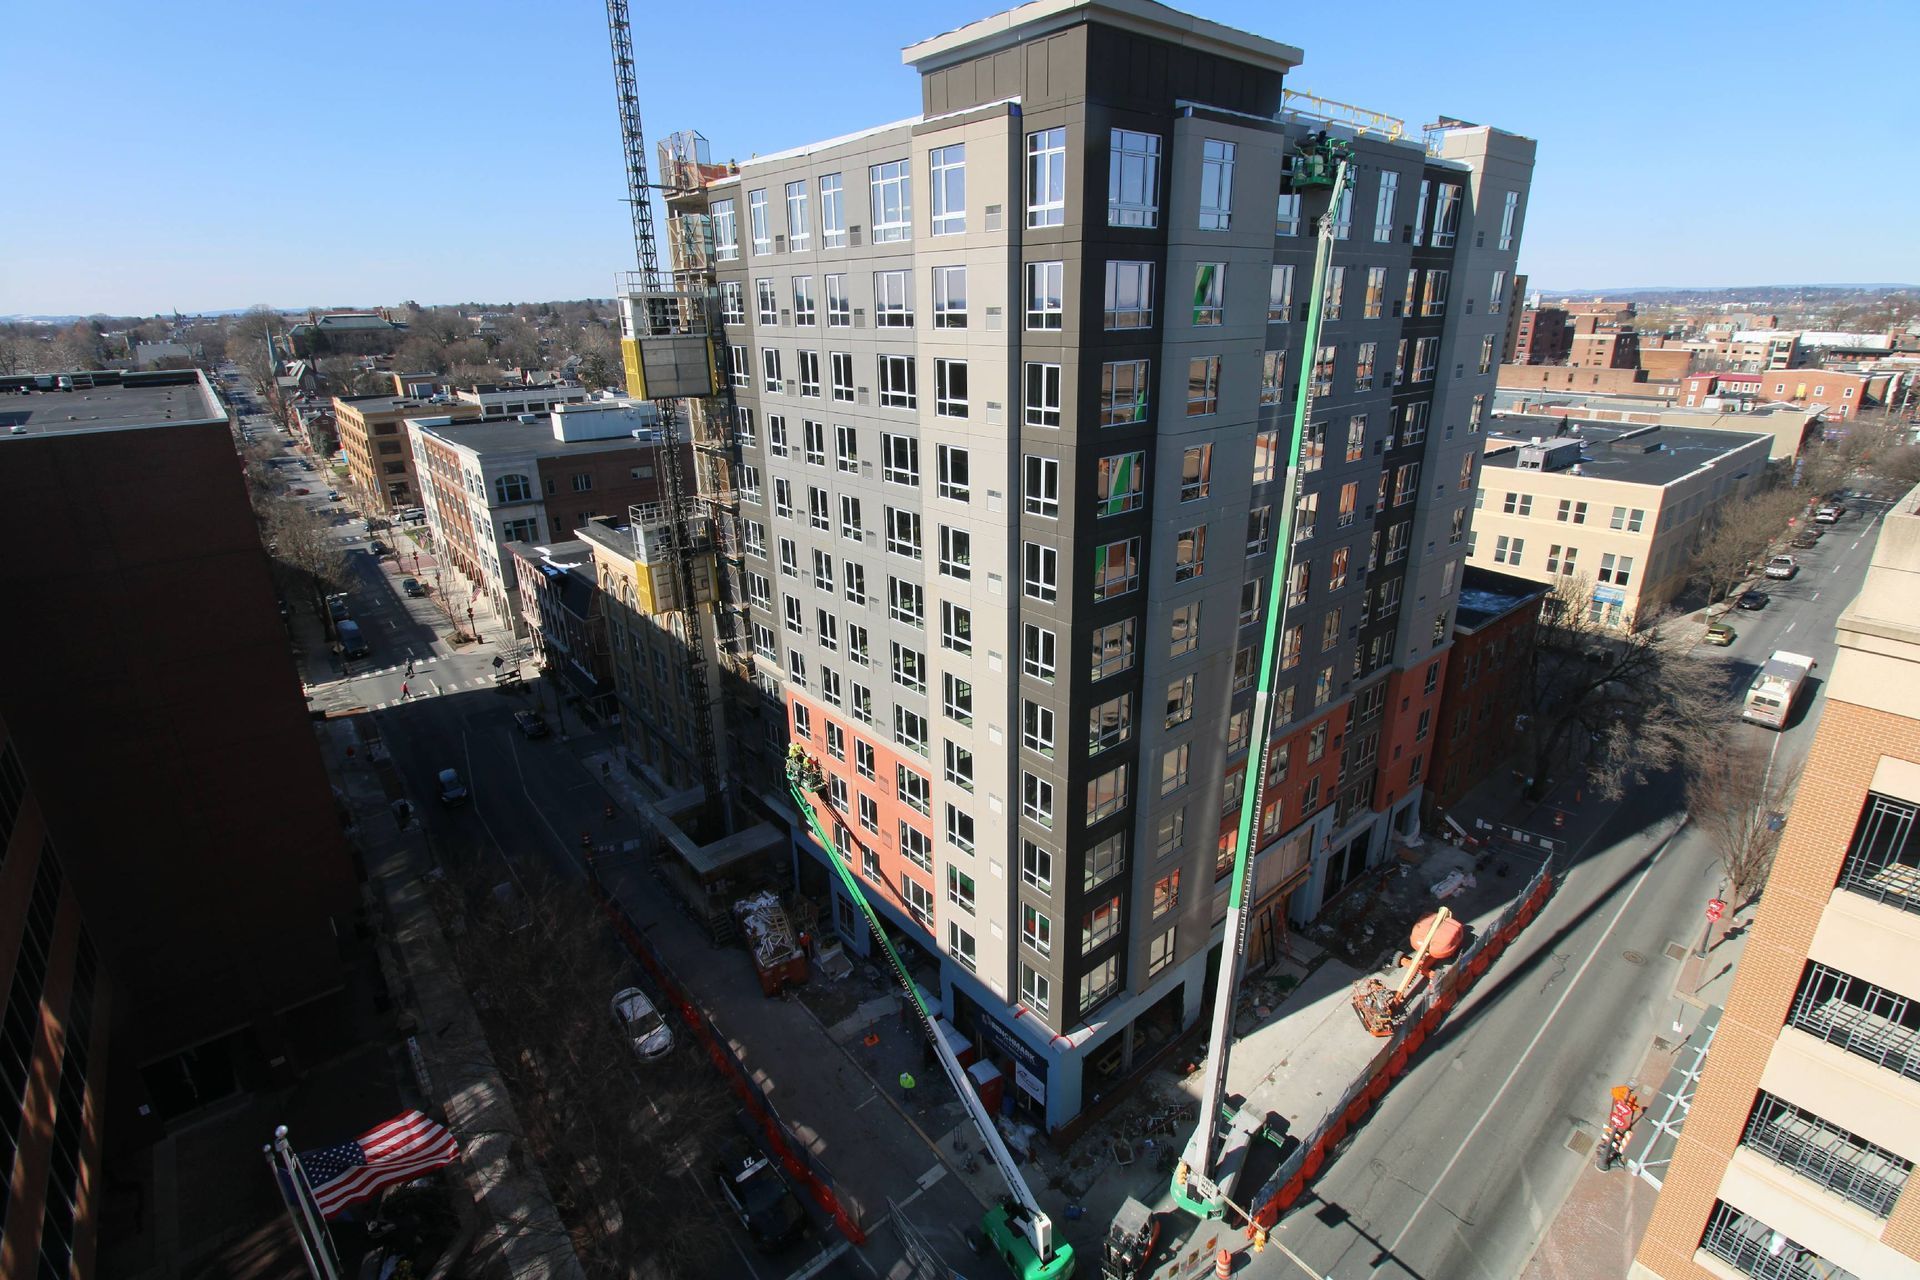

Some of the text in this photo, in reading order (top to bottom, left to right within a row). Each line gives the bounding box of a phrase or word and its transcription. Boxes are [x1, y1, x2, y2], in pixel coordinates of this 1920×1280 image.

[991, 1020, 1036, 1065] BENCHMARK
[743, 1156, 755, 1169] 27
[1201, 1176, 1214, 1189] ONE
[1201, 1183, 1213, 1195] WAY
